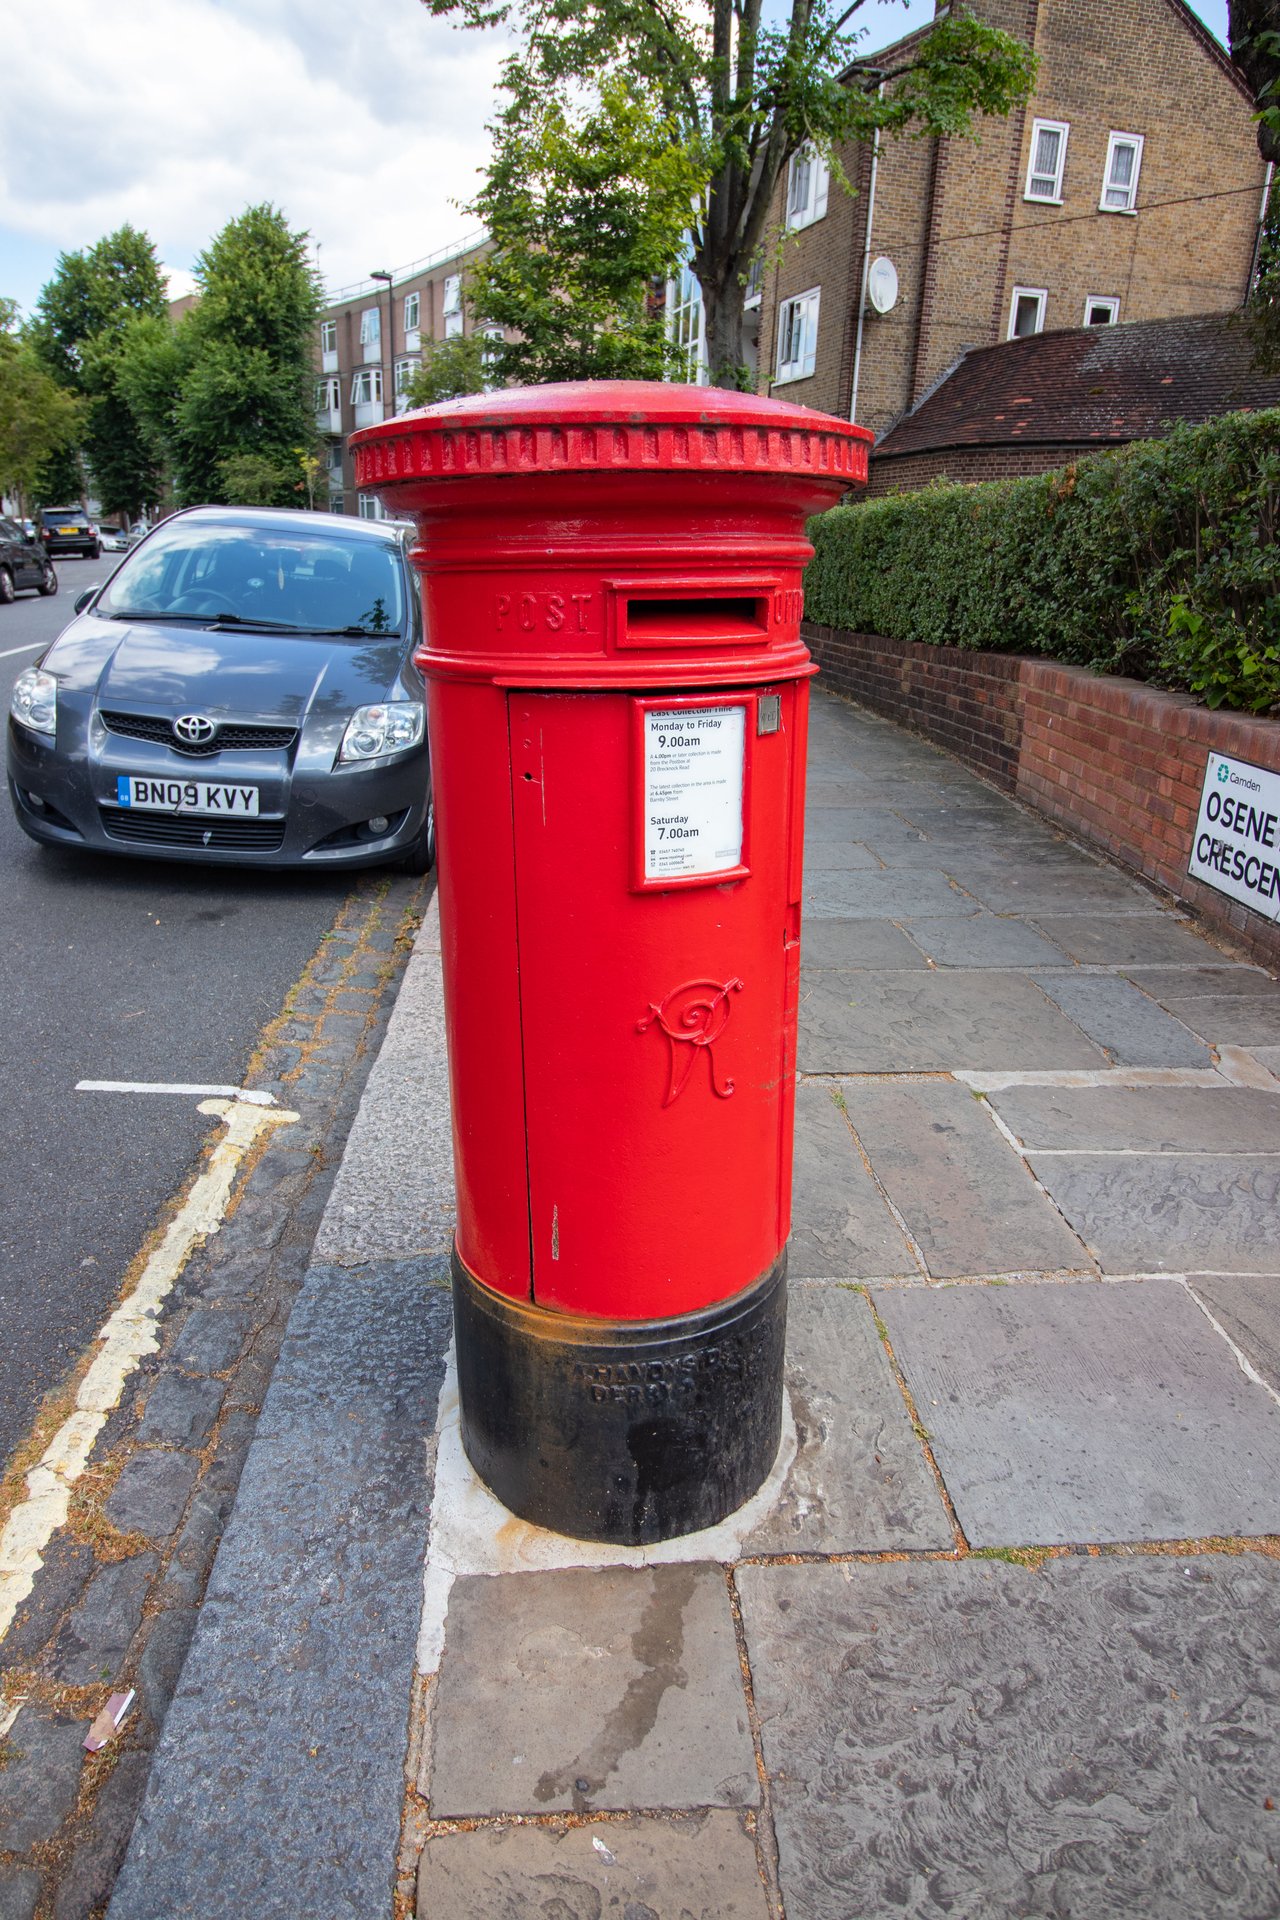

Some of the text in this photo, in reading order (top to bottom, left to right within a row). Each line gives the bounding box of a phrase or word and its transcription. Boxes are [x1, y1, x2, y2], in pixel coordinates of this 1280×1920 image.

[495, 592, 592, 631] POST
[651, 719, 722, 732] Monday to Friday
[658, 735, 701, 748] 9.00am
[1229, 772, 1261, 793] Camden
[134, 781, 254, 810] BN09 KVY
[650, 815, 689, 826] Saturday
[1206, 791, 1280, 850] OSENE
[658, 827, 699, 840] 7.00am
